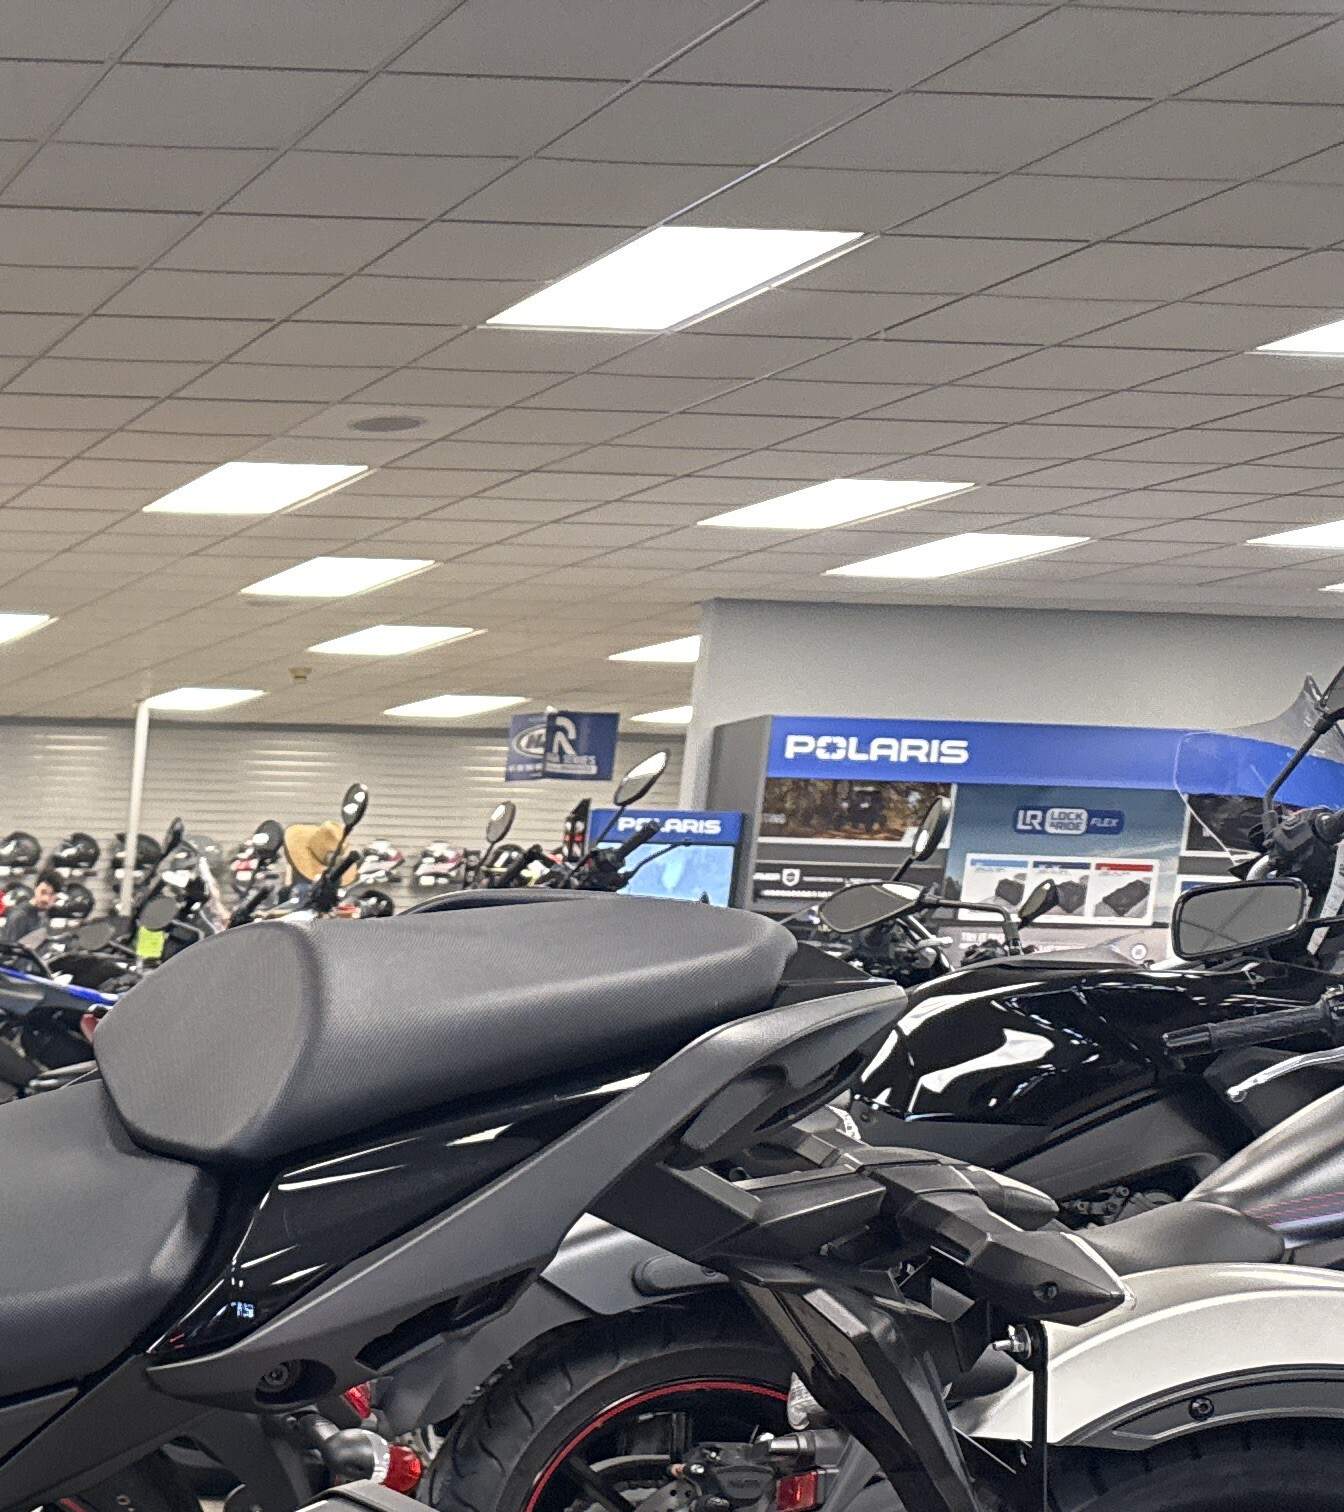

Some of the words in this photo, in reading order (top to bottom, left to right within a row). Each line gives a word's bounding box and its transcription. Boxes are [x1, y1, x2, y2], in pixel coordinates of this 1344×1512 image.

[783, 733, 970, 764] POLARIS
[1051, 810, 1084, 820] LOCK
[1090, 817, 1119, 827] FLEX
